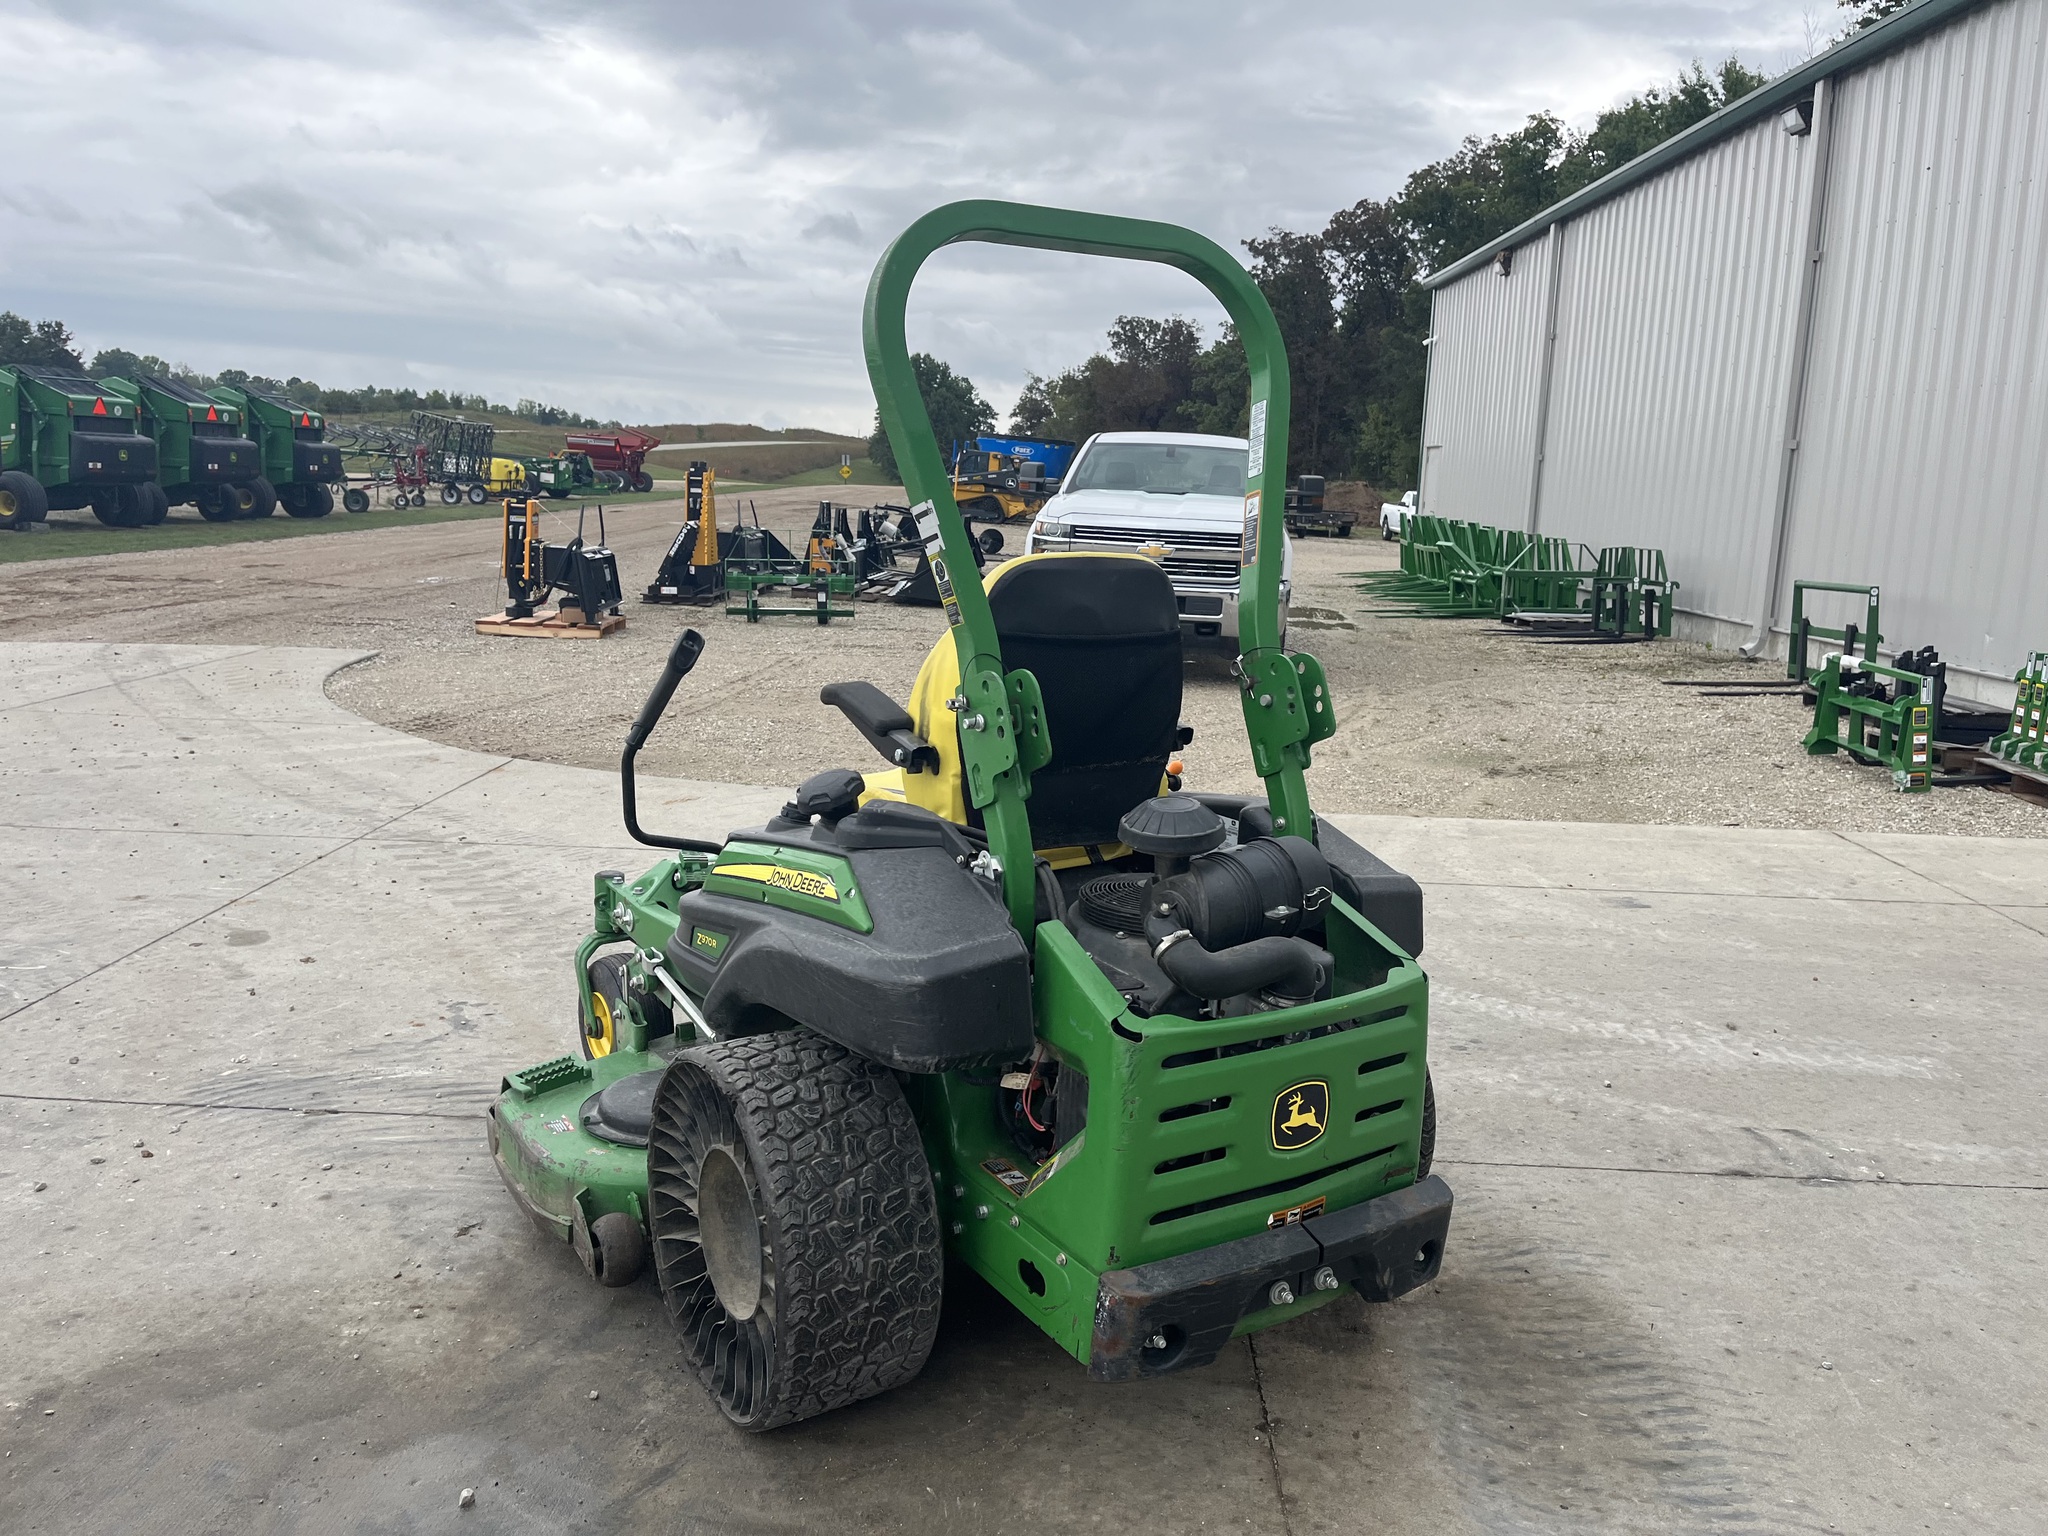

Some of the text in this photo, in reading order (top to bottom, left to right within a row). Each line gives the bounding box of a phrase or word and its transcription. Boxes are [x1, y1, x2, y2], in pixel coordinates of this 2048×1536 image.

[766, 868, 828, 895] JOHN DEERE
[697, 932, 717, 948] Z970R
